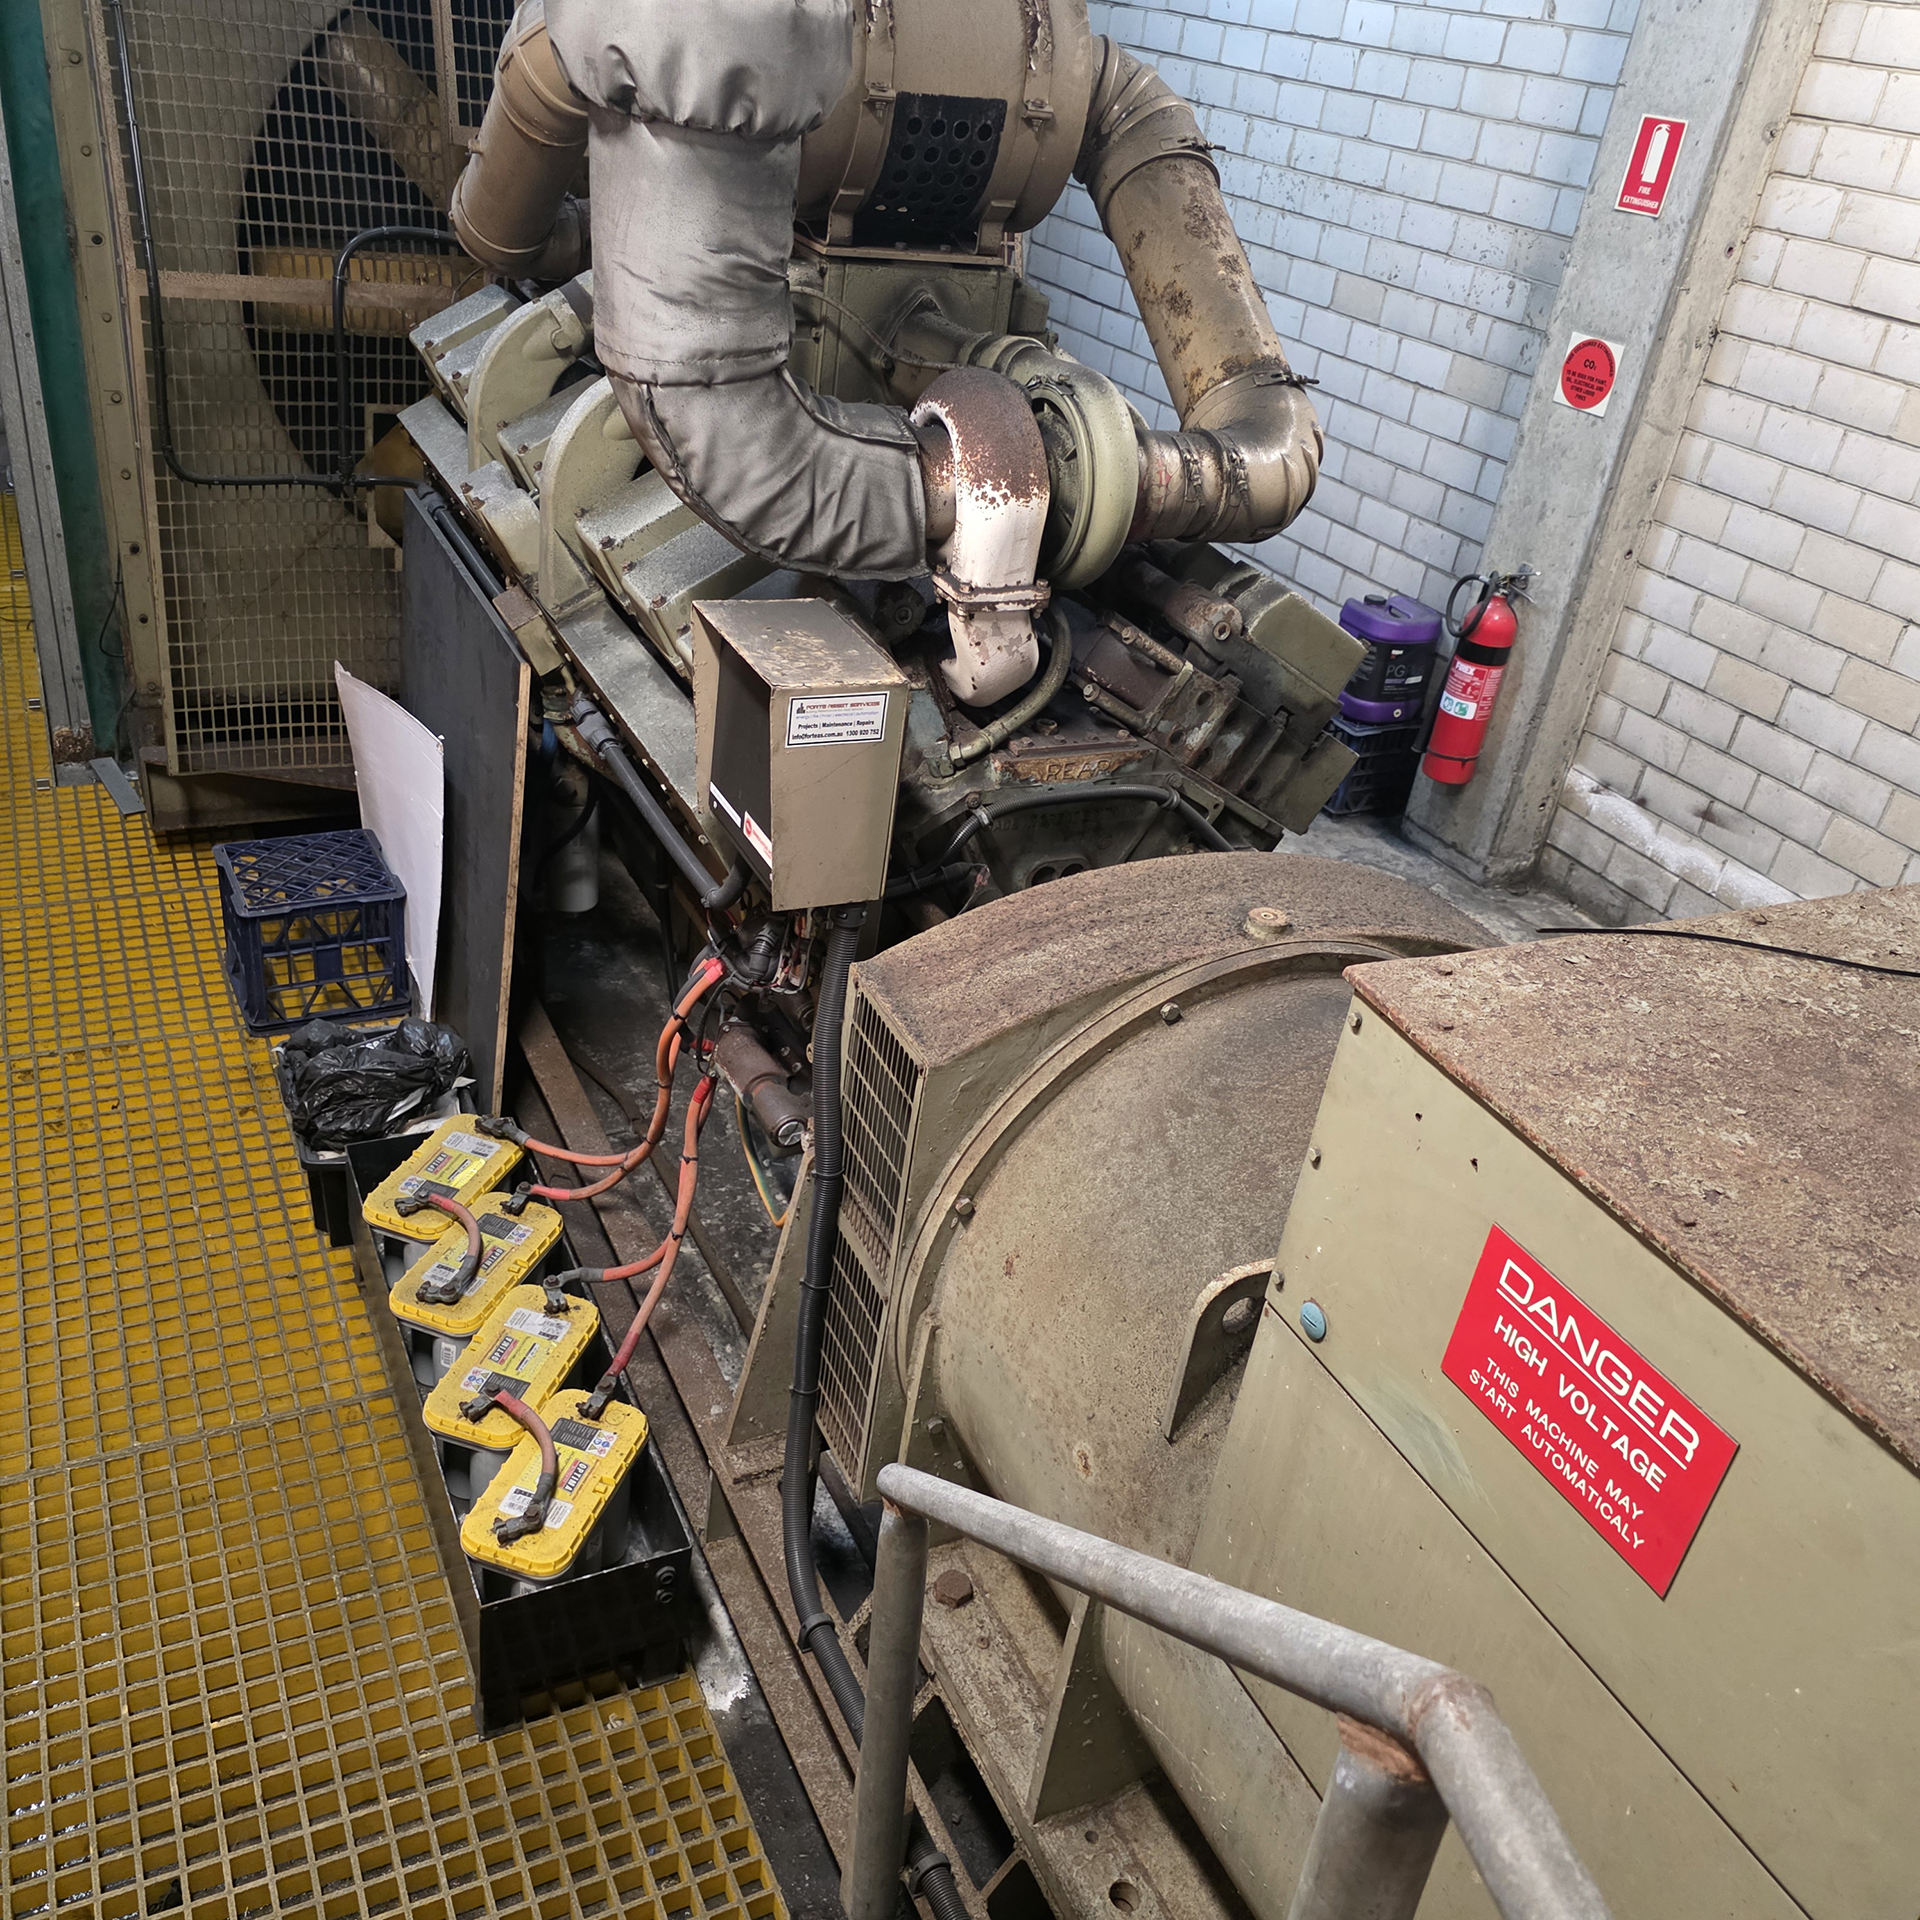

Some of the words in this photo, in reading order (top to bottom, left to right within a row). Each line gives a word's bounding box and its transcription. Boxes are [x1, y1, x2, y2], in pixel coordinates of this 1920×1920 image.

[1622, 195, 1659, 209] EXTINGUISHER
[1638, 186, 1651, 195] FIRE
[1386, 665, 1406, 677] PG
[1045, 759, 1111, 781] REAR
[427, 1152, 448, 1173] OPTIMA
[481, 1248, 503, 1270] OPTIMA
[491, 1336, 513, 1362] OPTIMA
[1498, 1258, 1700, 1462] DANGER
[1494, 1315, 1548, 1377] HIGH
[1557, 1374, 1667, 1492] VOLTAGE
[1486, 1357, 1519, 1398] THIS
[1525, 1399, 1599, 1479] MACHINE
[1605, 1479, 1644, 1520] MAY
[1469, 1369, 1517, 1419] START
[1521, 1424, 1644, 1549] AUTOMATICALY
[565, 1462, 587, 1492] OPTIMA
